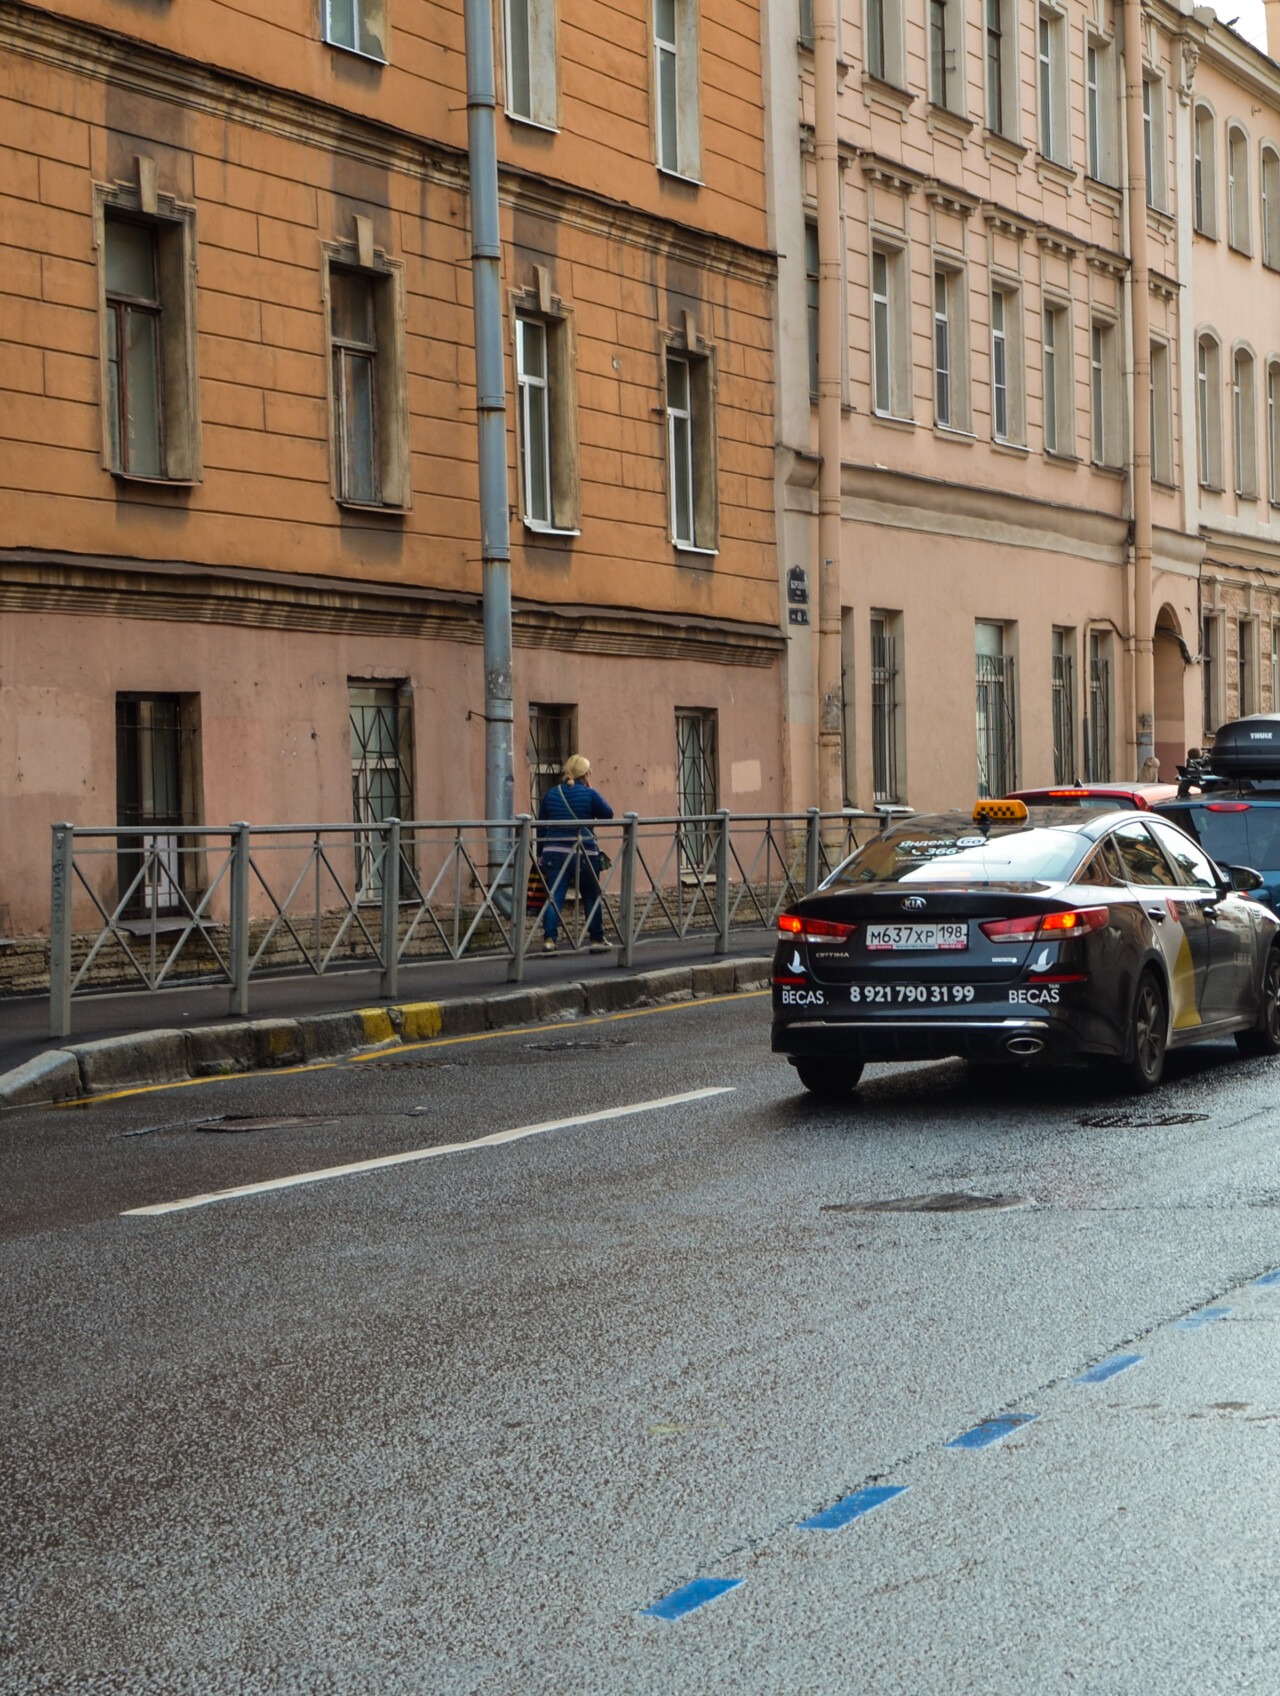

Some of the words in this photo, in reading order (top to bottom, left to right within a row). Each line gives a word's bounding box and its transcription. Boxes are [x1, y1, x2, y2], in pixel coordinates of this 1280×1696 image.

[903, 899, 922, 909] KIA
[939, 926, 963, 939] 198
[782, 990, 825, 1005] BECAS
[850, 986, 860, 1002] 8
[864, 986, 892, 1002] 921
[896, 986, 927, 1002] 790
[930, 986, 949, 1002] 31
[952, 985, 975, 1002] 99
[1008, 989, 1060, 1004] BECAS
